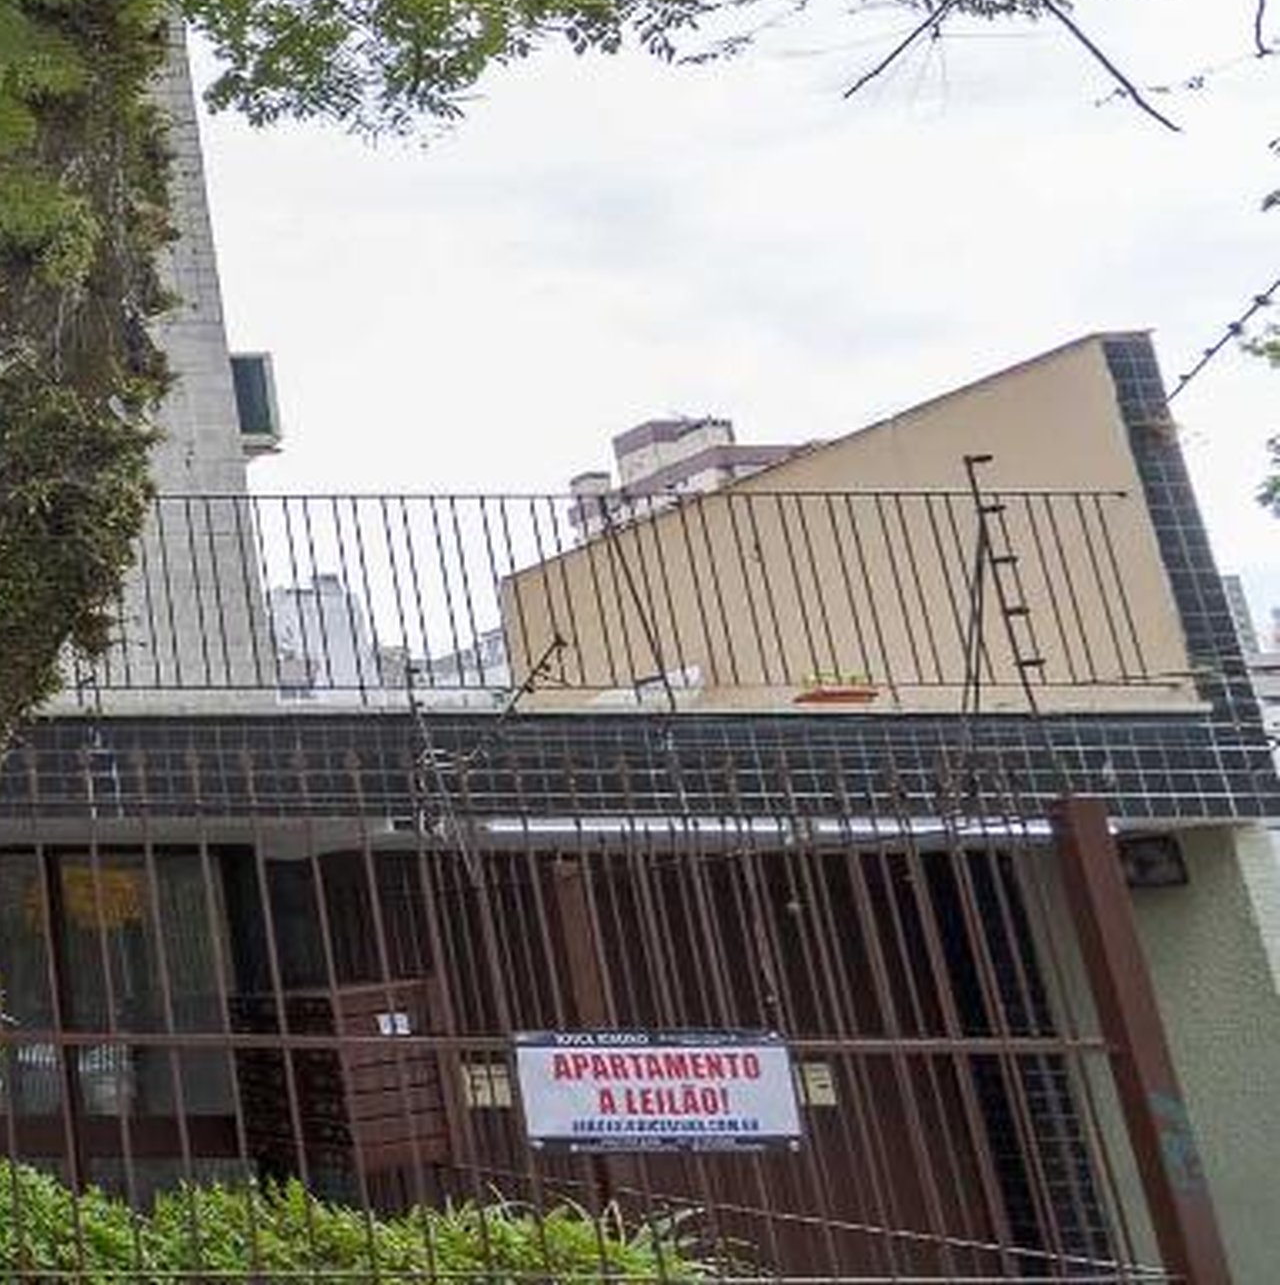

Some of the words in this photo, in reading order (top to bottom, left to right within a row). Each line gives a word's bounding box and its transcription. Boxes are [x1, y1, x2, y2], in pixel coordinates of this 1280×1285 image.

[552, 1051, 762, 1081] APARTAMENTO
[598, 1088, 618, 1115] A
[627, 1083, 730, 1116] LEILÃO!
